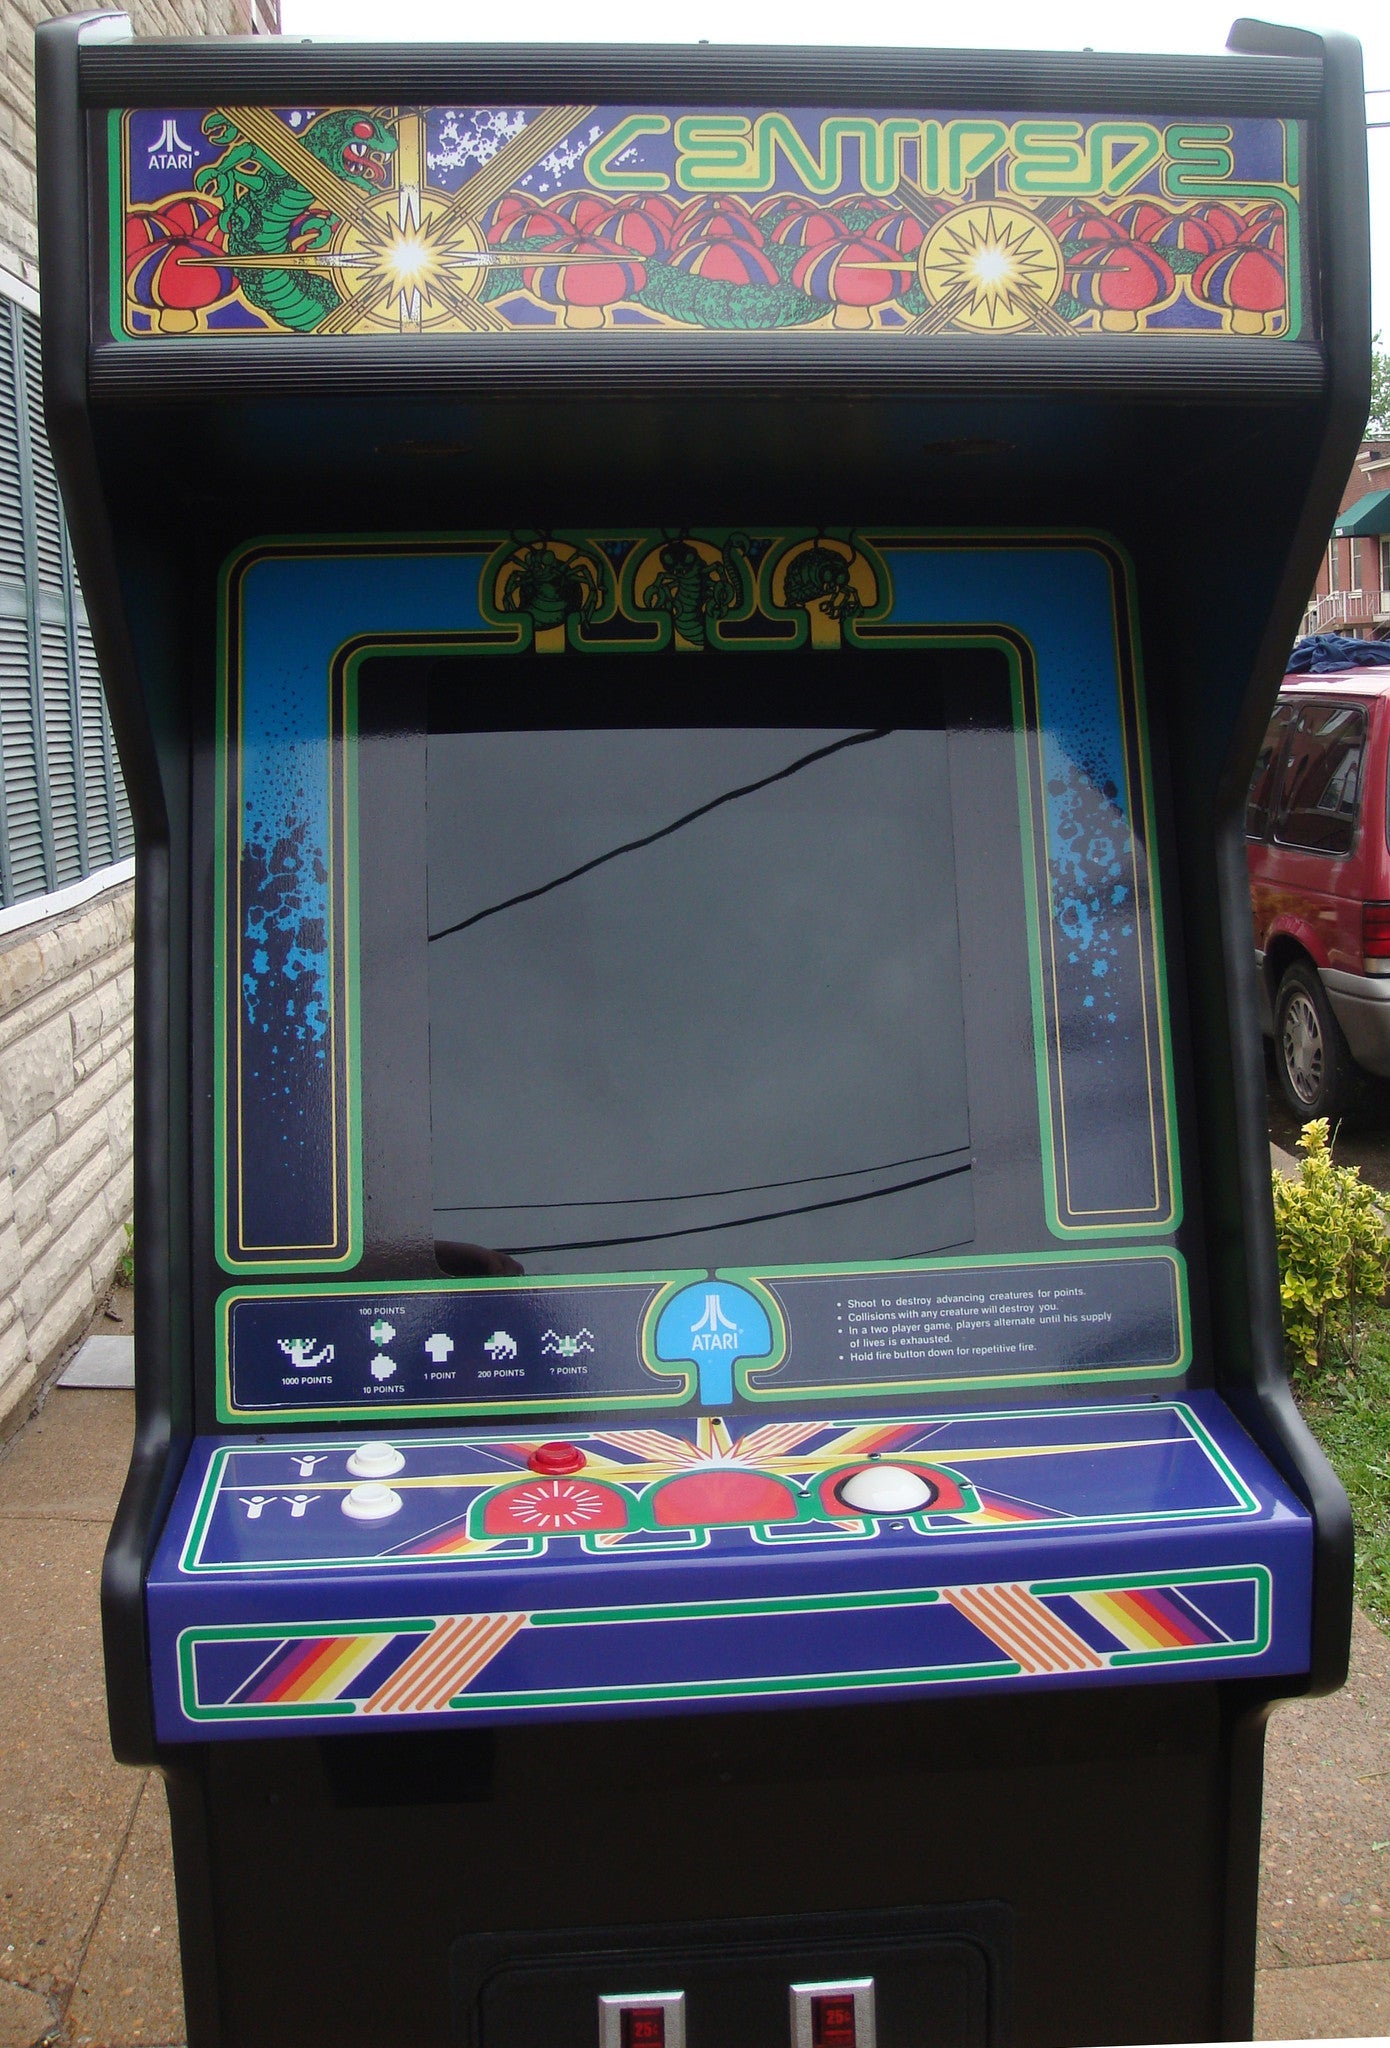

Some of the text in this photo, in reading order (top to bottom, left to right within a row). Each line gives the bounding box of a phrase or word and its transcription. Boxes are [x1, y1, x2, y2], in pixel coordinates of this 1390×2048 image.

[148, 154, 193, 169] ATARI
[582, 109, 1235, 199] CENTIPEDE
[847, 1287, 1086, 1309] Shoot to destroy advancing creatures for points.
[848, 1303, 1059, 1322] Collisions with any creature will destroy you.
[849, 1326, 858, 1335] In
[861, 1326, 868, 1335] a
[871, 1324, 889, 1334] two
[891, 1324, 921, 1334] player
[956, 1319, 991, 1331] players
[993, 1316, 1036, 1327] alternate
[1039, 1314, 1061, 1325] until
[1063, 1313, 1078, 1323] his
[1080, 1311, 1112, 1323] supply
[692, 1333, 738, 1351] ATARI
[850, 1334, 953, 1348] of lives is exhausted.
[850, 1342, 1037, 1362] Hold fire button down for repetitive fire.
[430, 1372, 456, 1380] POINT
[493, 1369, 525, 1377] POINTS
[557, 1366, 588, 1374] POINTS
[282, 1376, 333, 1385] 1000 POINTS
[373, 1385, 405, 1393] POINTS
